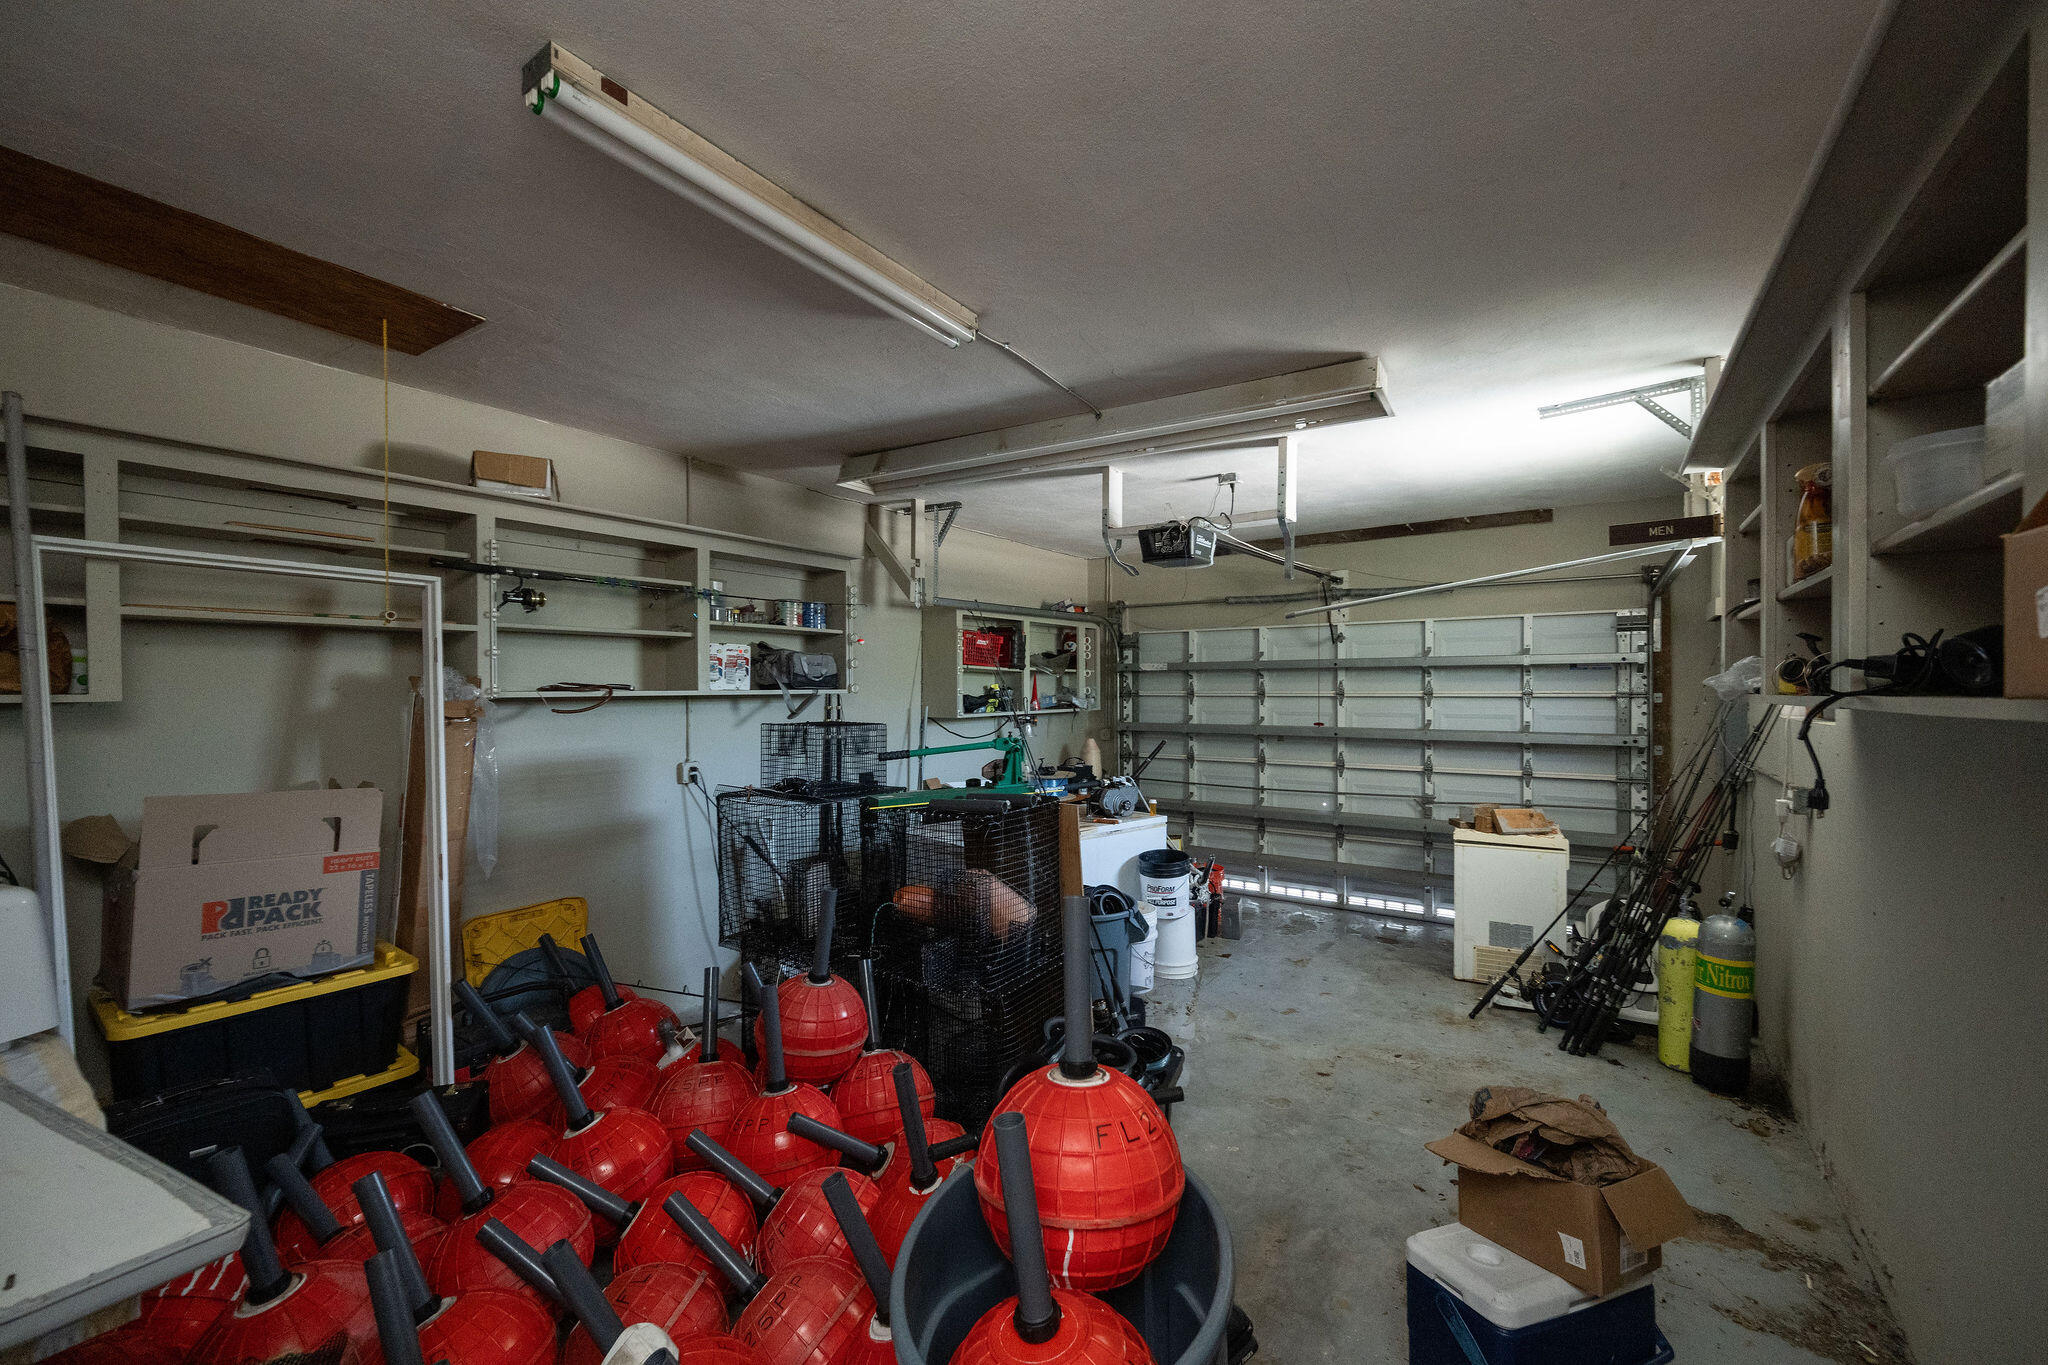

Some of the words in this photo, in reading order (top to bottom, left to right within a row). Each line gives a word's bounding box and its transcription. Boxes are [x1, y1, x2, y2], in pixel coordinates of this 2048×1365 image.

[1649, 525, 1674, 536] MEN
[356, 854, 374, 862] DUTY
[248, 887, 325, 910] READY
[363, 872, 375, 914] TAPELESS
[247, 901, 322, 927] PACK
[200, 931, 226, 941] PACK
[256, 924, 280, 933] PACK
